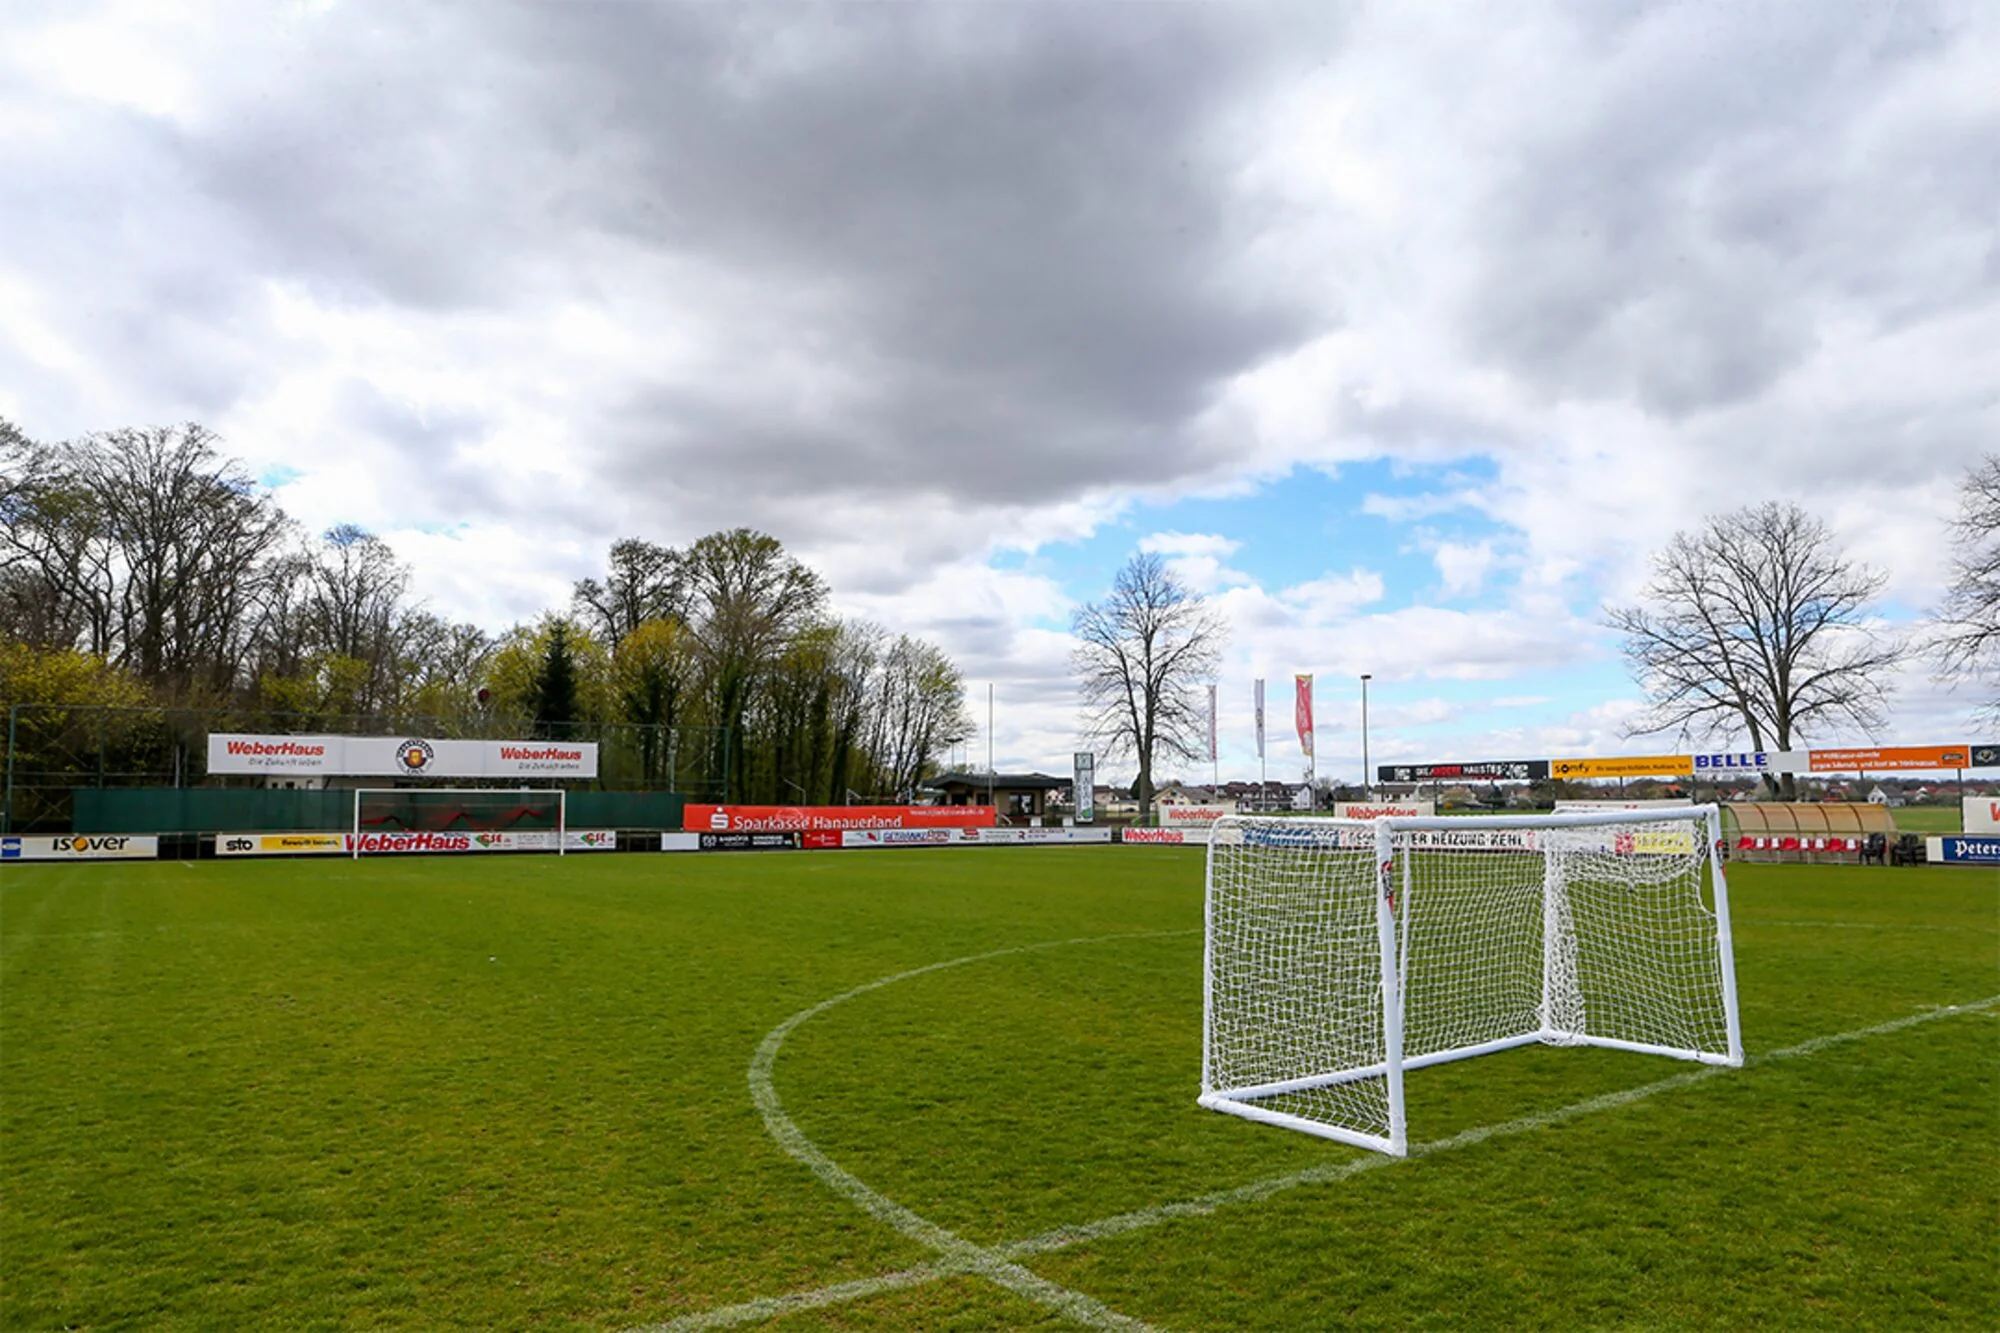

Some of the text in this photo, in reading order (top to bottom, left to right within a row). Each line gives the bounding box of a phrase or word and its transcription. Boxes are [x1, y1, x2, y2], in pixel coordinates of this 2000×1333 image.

[227, 741, 325, 756] WeberHaus
[500, 747, 582, 761] WeberHaus
[1695, 753, 1768, 767] BELLE
[1555, 762, 1590, 773] somfy
[1168, 808, 1224, 820] WeberHaus
[734, 814, 808, 831] Sparkasse
[813, 814, 902, 829] Hanauerland
[346, 833, 470, 851] WeberHaus
[1124, 828, 1184, 842] WeberHaus
[1955, 840, 2000, 858] Peter
